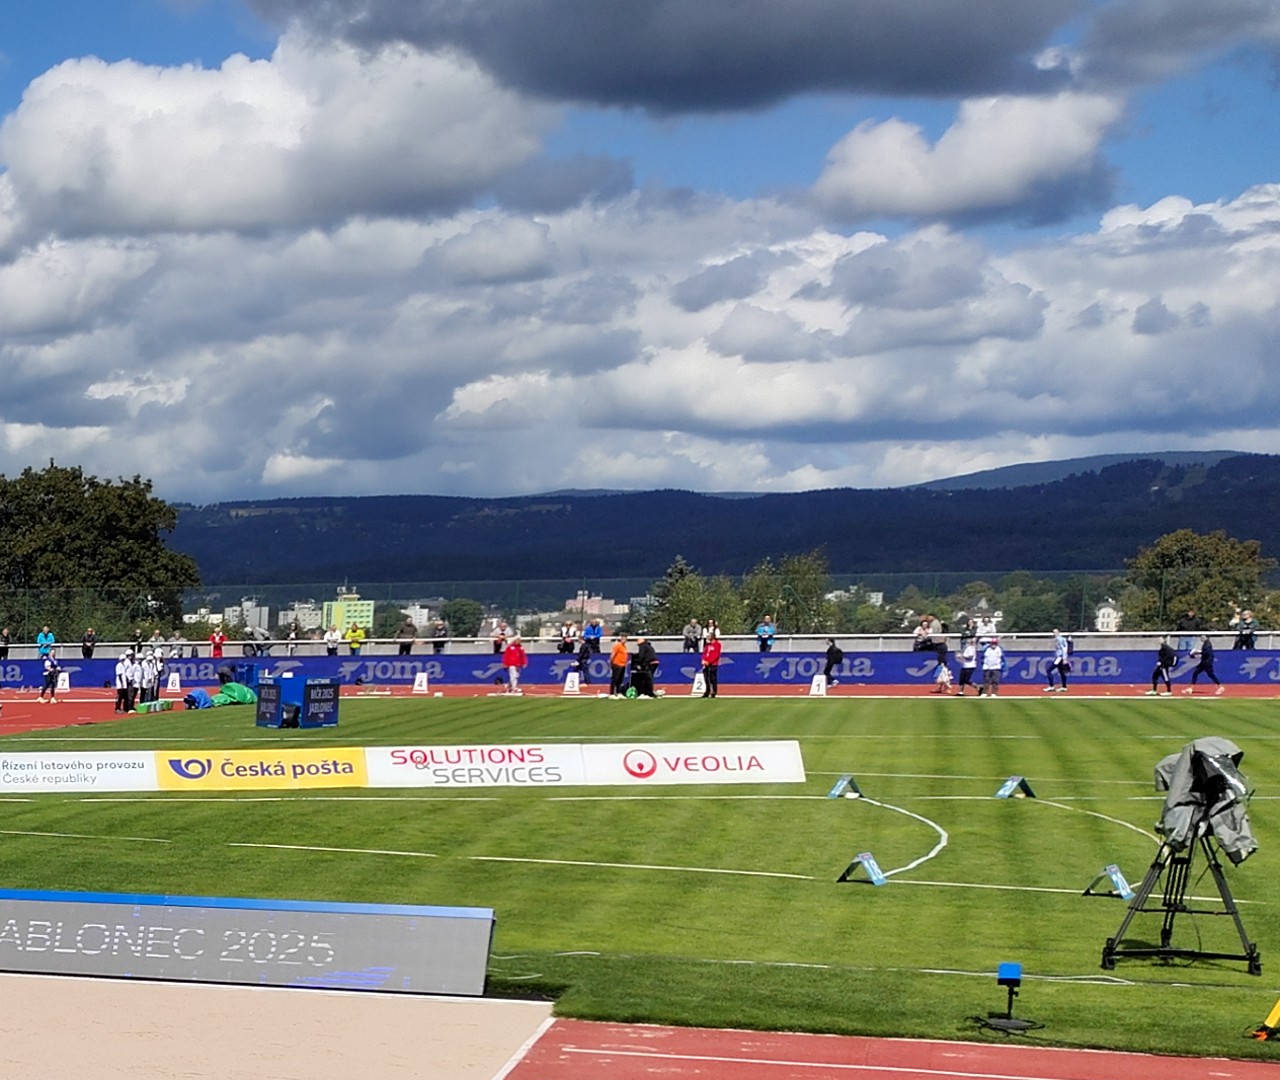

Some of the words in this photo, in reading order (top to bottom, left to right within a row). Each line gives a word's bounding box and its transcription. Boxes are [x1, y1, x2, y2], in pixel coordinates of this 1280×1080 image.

[360, 658, 445, 684] Joma
[390, 747, 545, 765] SOLUTIONS
[663, 755, 765, 772] VEOLIA
[1, 759, 38, 771] Řízení
[40, 760, 93, 772] letového
[96, 761, 145, 772] provozu
[220, 757, 286, 778] Česká
[292, 758, 354, 781] pošta
[2, 773, 39, 785] České
[42, 772, 97, 786] republiky
[433, 766, 563, 785] SERVICES
[218, 929, 336, 967] 2025
